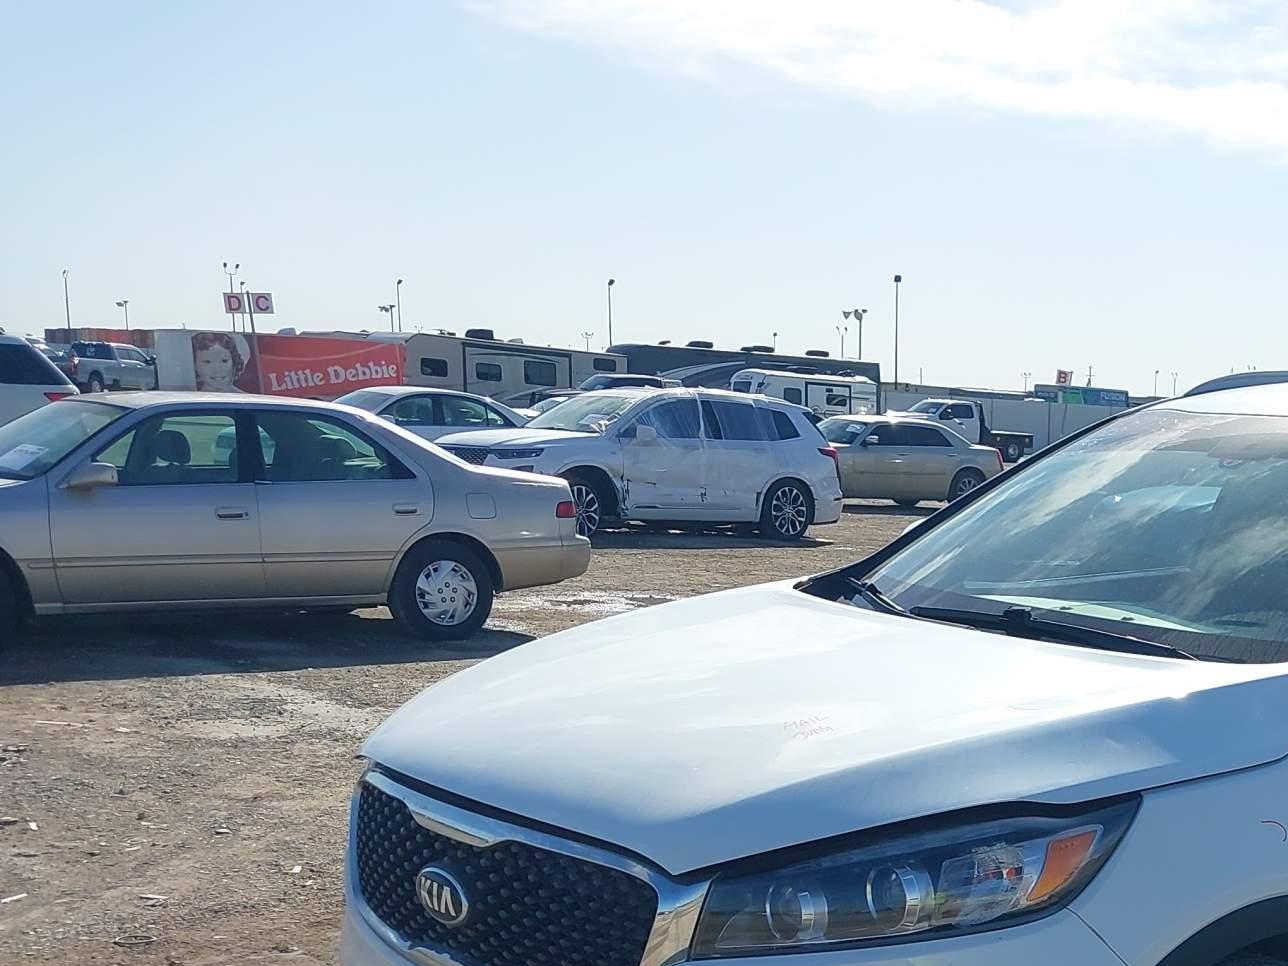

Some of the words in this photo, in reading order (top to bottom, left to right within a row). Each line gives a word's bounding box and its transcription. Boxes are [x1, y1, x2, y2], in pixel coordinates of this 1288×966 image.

[227, 295, 241, 311] D
[255, 295, 269, 311] C
[269, 370, 325, 391] Little
[327, 361, 398, 384] Debbie
[1059, 371, 1068, 384] B
[420, 875, 457, 917] KIA
